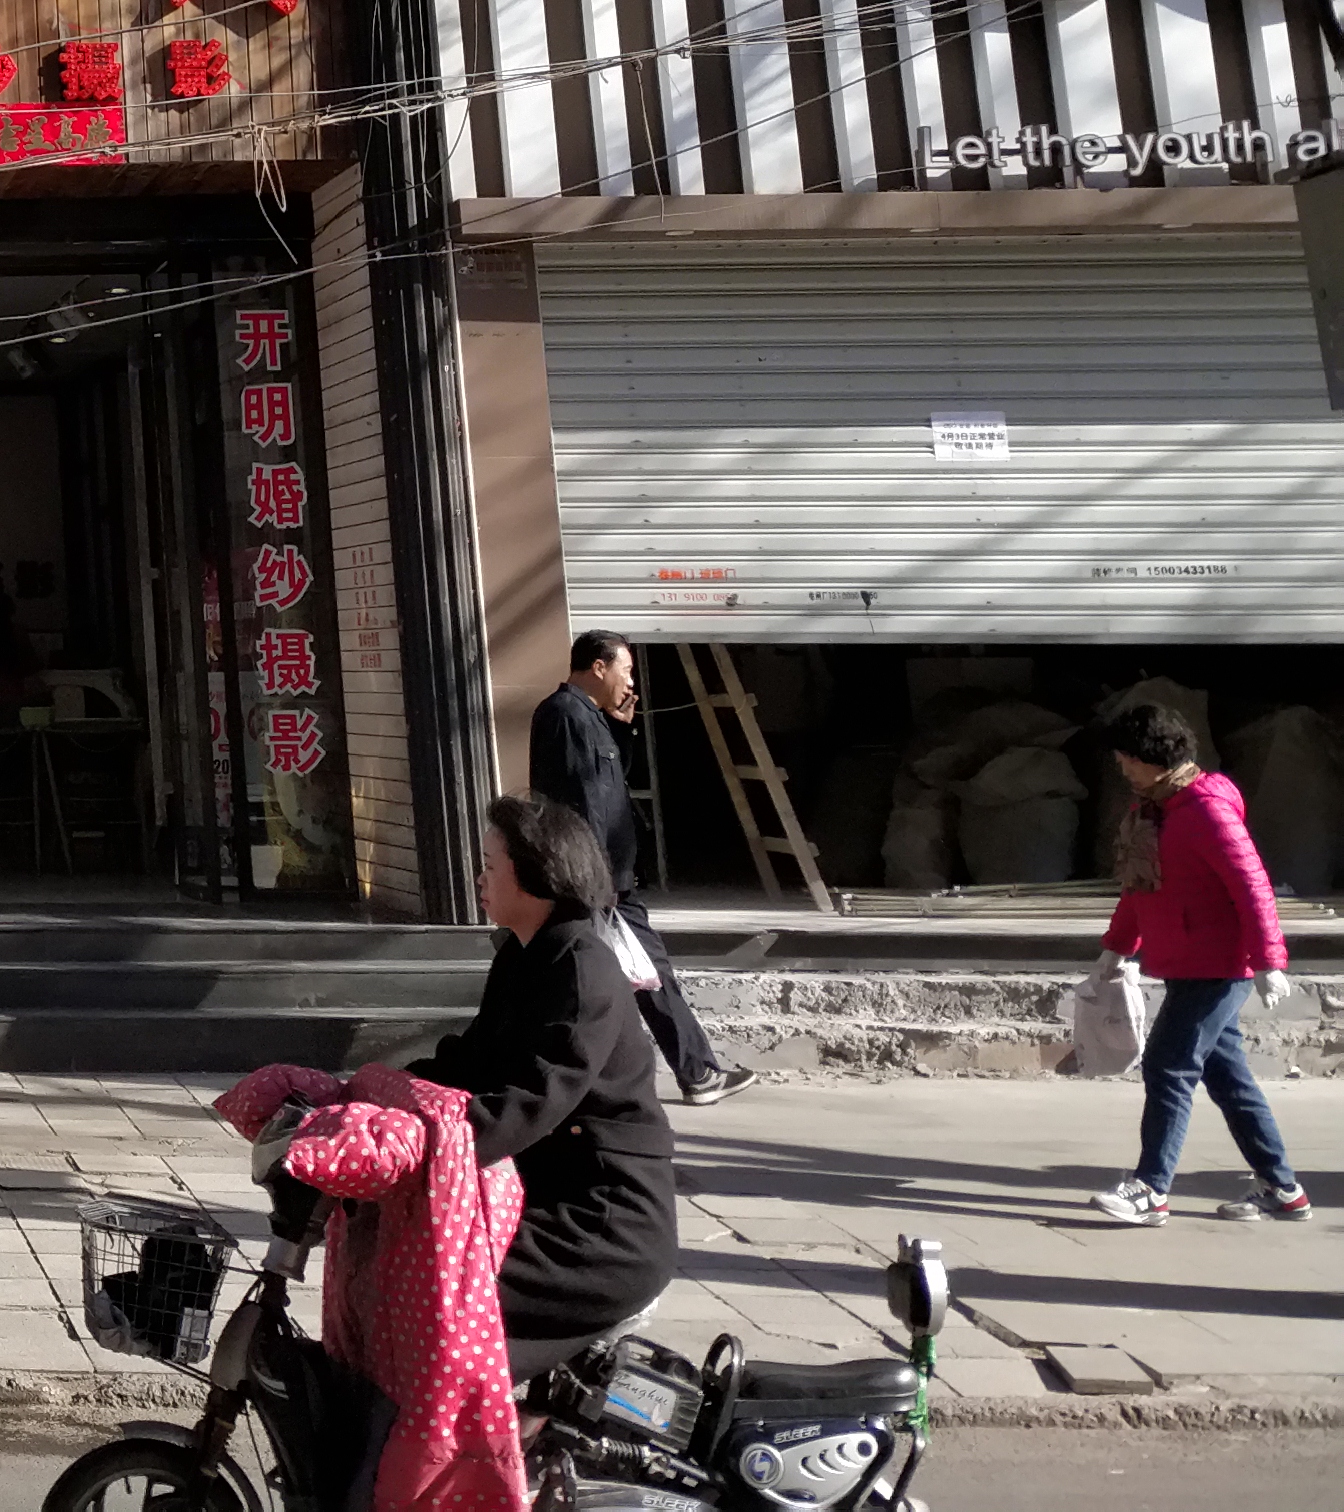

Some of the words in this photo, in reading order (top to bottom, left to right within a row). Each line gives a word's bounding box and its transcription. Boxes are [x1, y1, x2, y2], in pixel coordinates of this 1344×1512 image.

[918, 125, 1008, 169] Let
[1020, 124, 1107, 167] the
[1124, 119, 1275, 176] youth
[235, 310, 327, 777] 开明婚纱摄影
[773, 1423, 823, 1444] SLEEK
